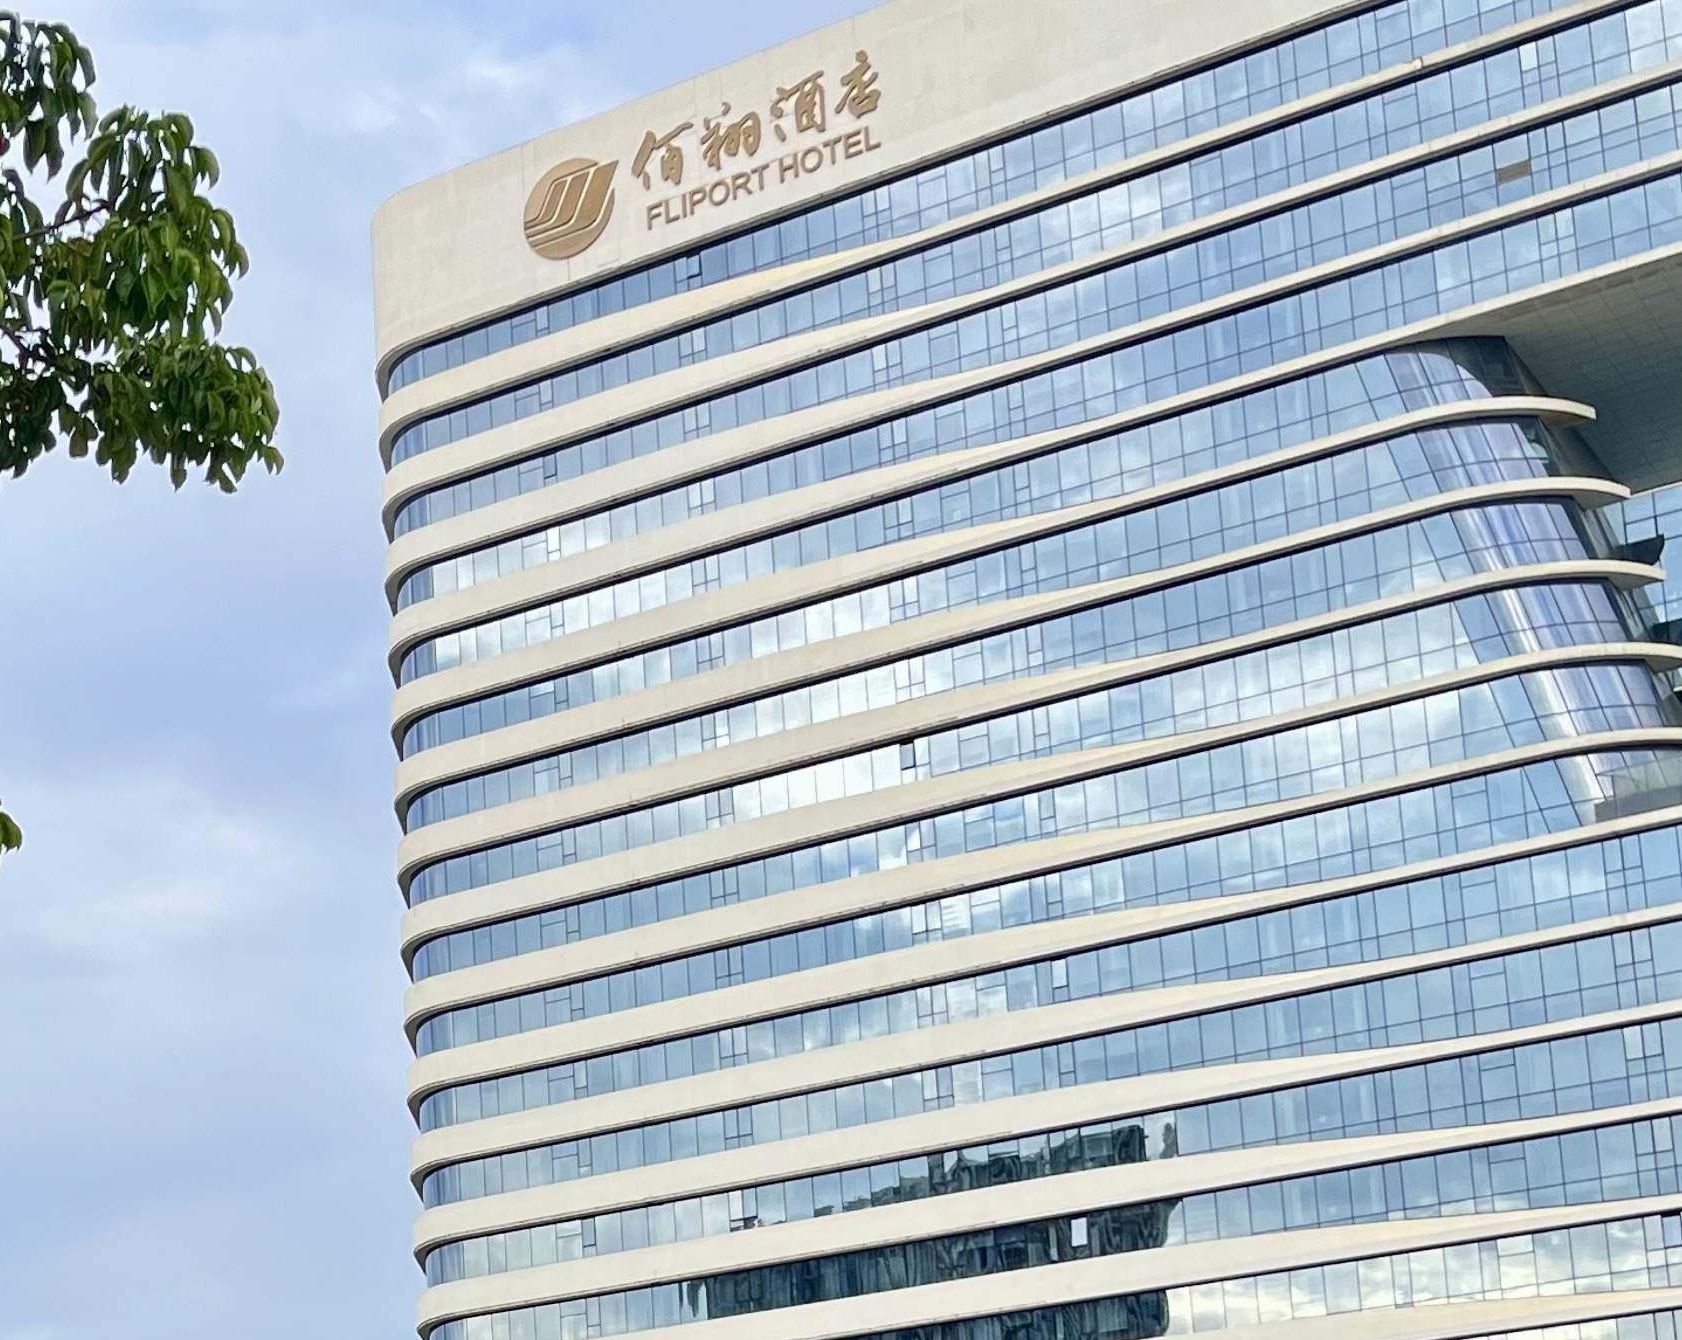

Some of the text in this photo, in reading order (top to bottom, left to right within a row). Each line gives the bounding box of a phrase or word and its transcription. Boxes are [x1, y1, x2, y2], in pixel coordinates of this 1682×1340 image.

[631, 50, 881, 190] 佰翔酒店
[646, 126, 881, 230] FLIPORT HOTEL
